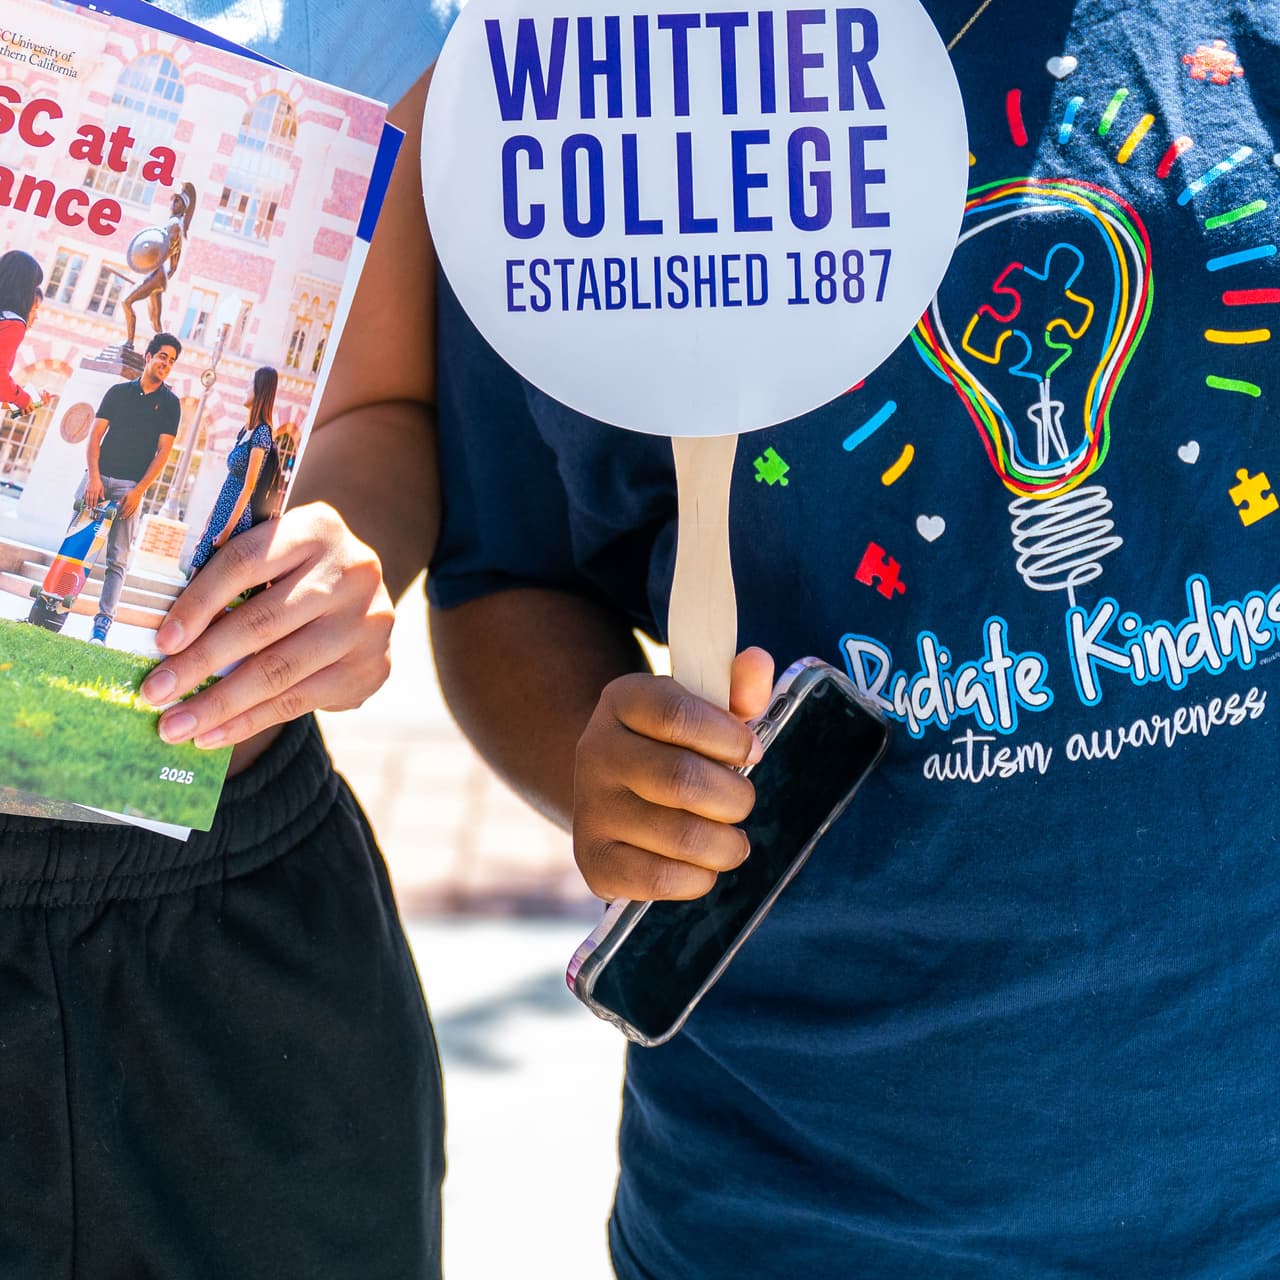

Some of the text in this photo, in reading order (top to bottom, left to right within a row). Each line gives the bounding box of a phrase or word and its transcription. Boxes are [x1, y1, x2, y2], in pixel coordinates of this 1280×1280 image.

[11, 32, 62, 64] University
[61, 51, 76, 63] of
[28, 53, 78, 79] California
[484, 7, 886, 121] WHITTIER
[69, 124, 136, 173] at
[141, 145, 178, 187] a
[501, 125, 891, 240] COLLEGE
[506, 249, 892, 313] ESTABLISHED 1887
[843, 619, 1050, 734] Radiate
[923, 686, 1269, 783] autism awareness
[159, 766, 195, 785] 2025
